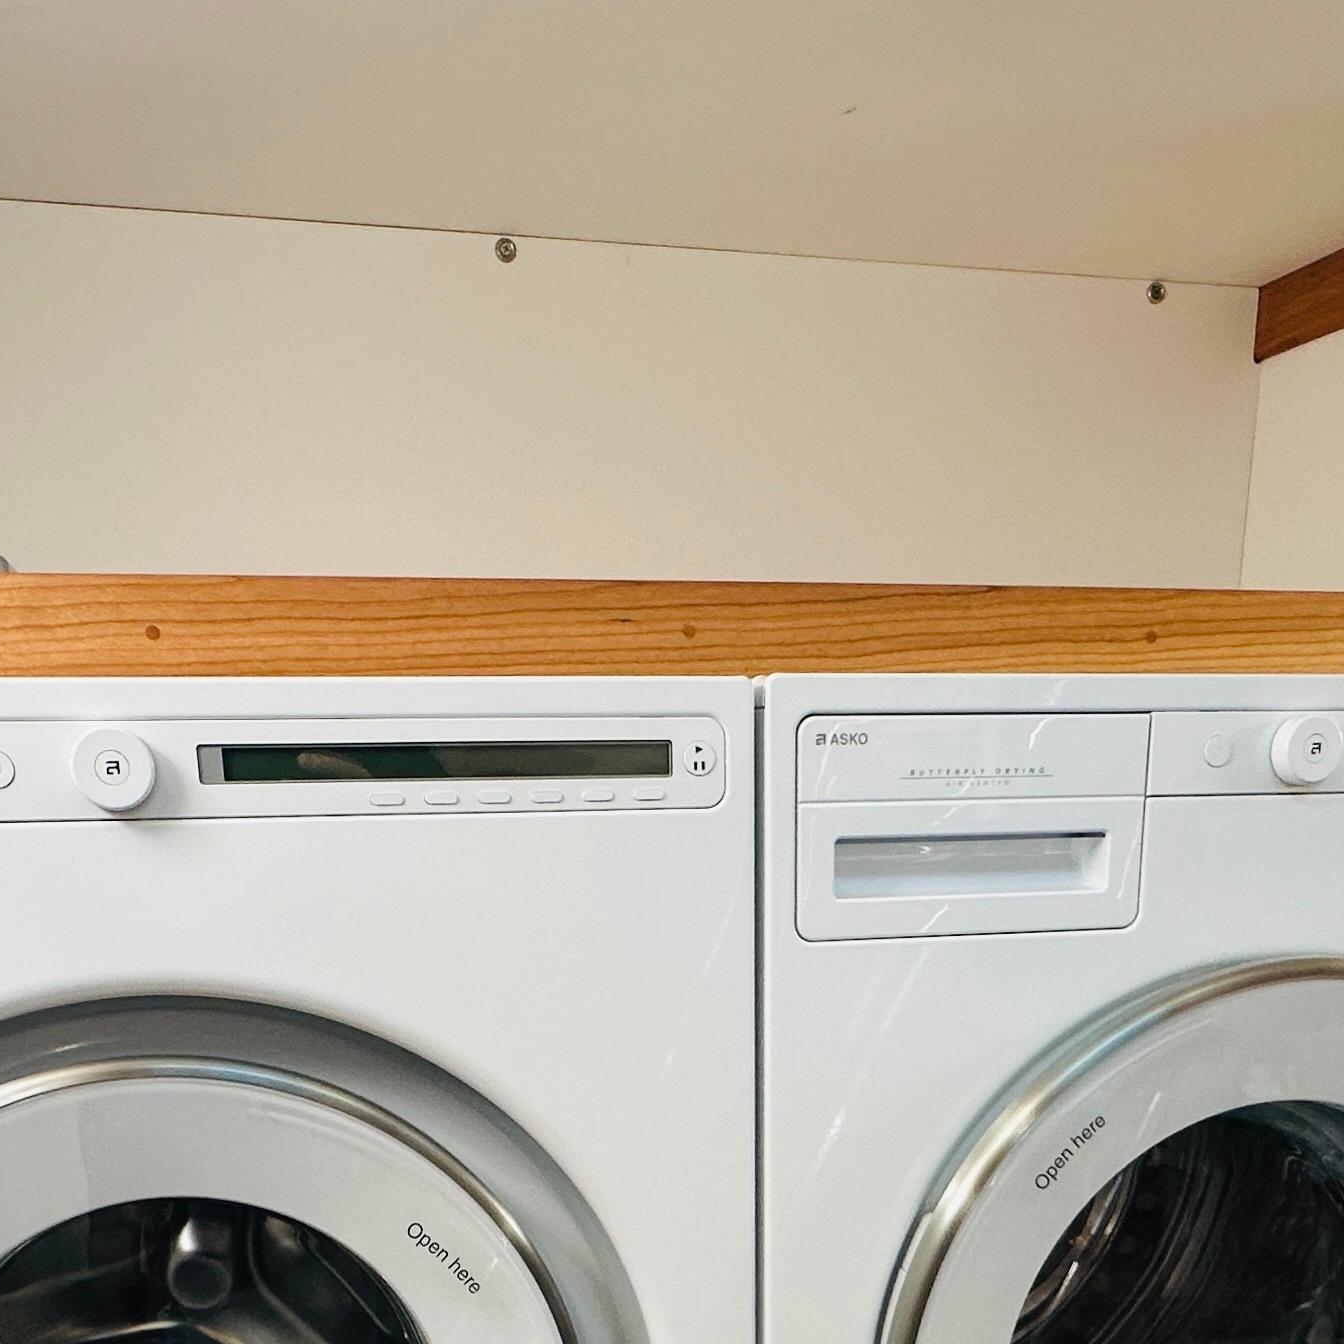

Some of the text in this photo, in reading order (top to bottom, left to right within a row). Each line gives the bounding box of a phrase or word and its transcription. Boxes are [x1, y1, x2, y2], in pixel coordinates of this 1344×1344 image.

[830, 732, 869, 746] ASKO
[1034, 1115, 1106, 1190] Open here
[406, 1221, 482, 1295] Open here
